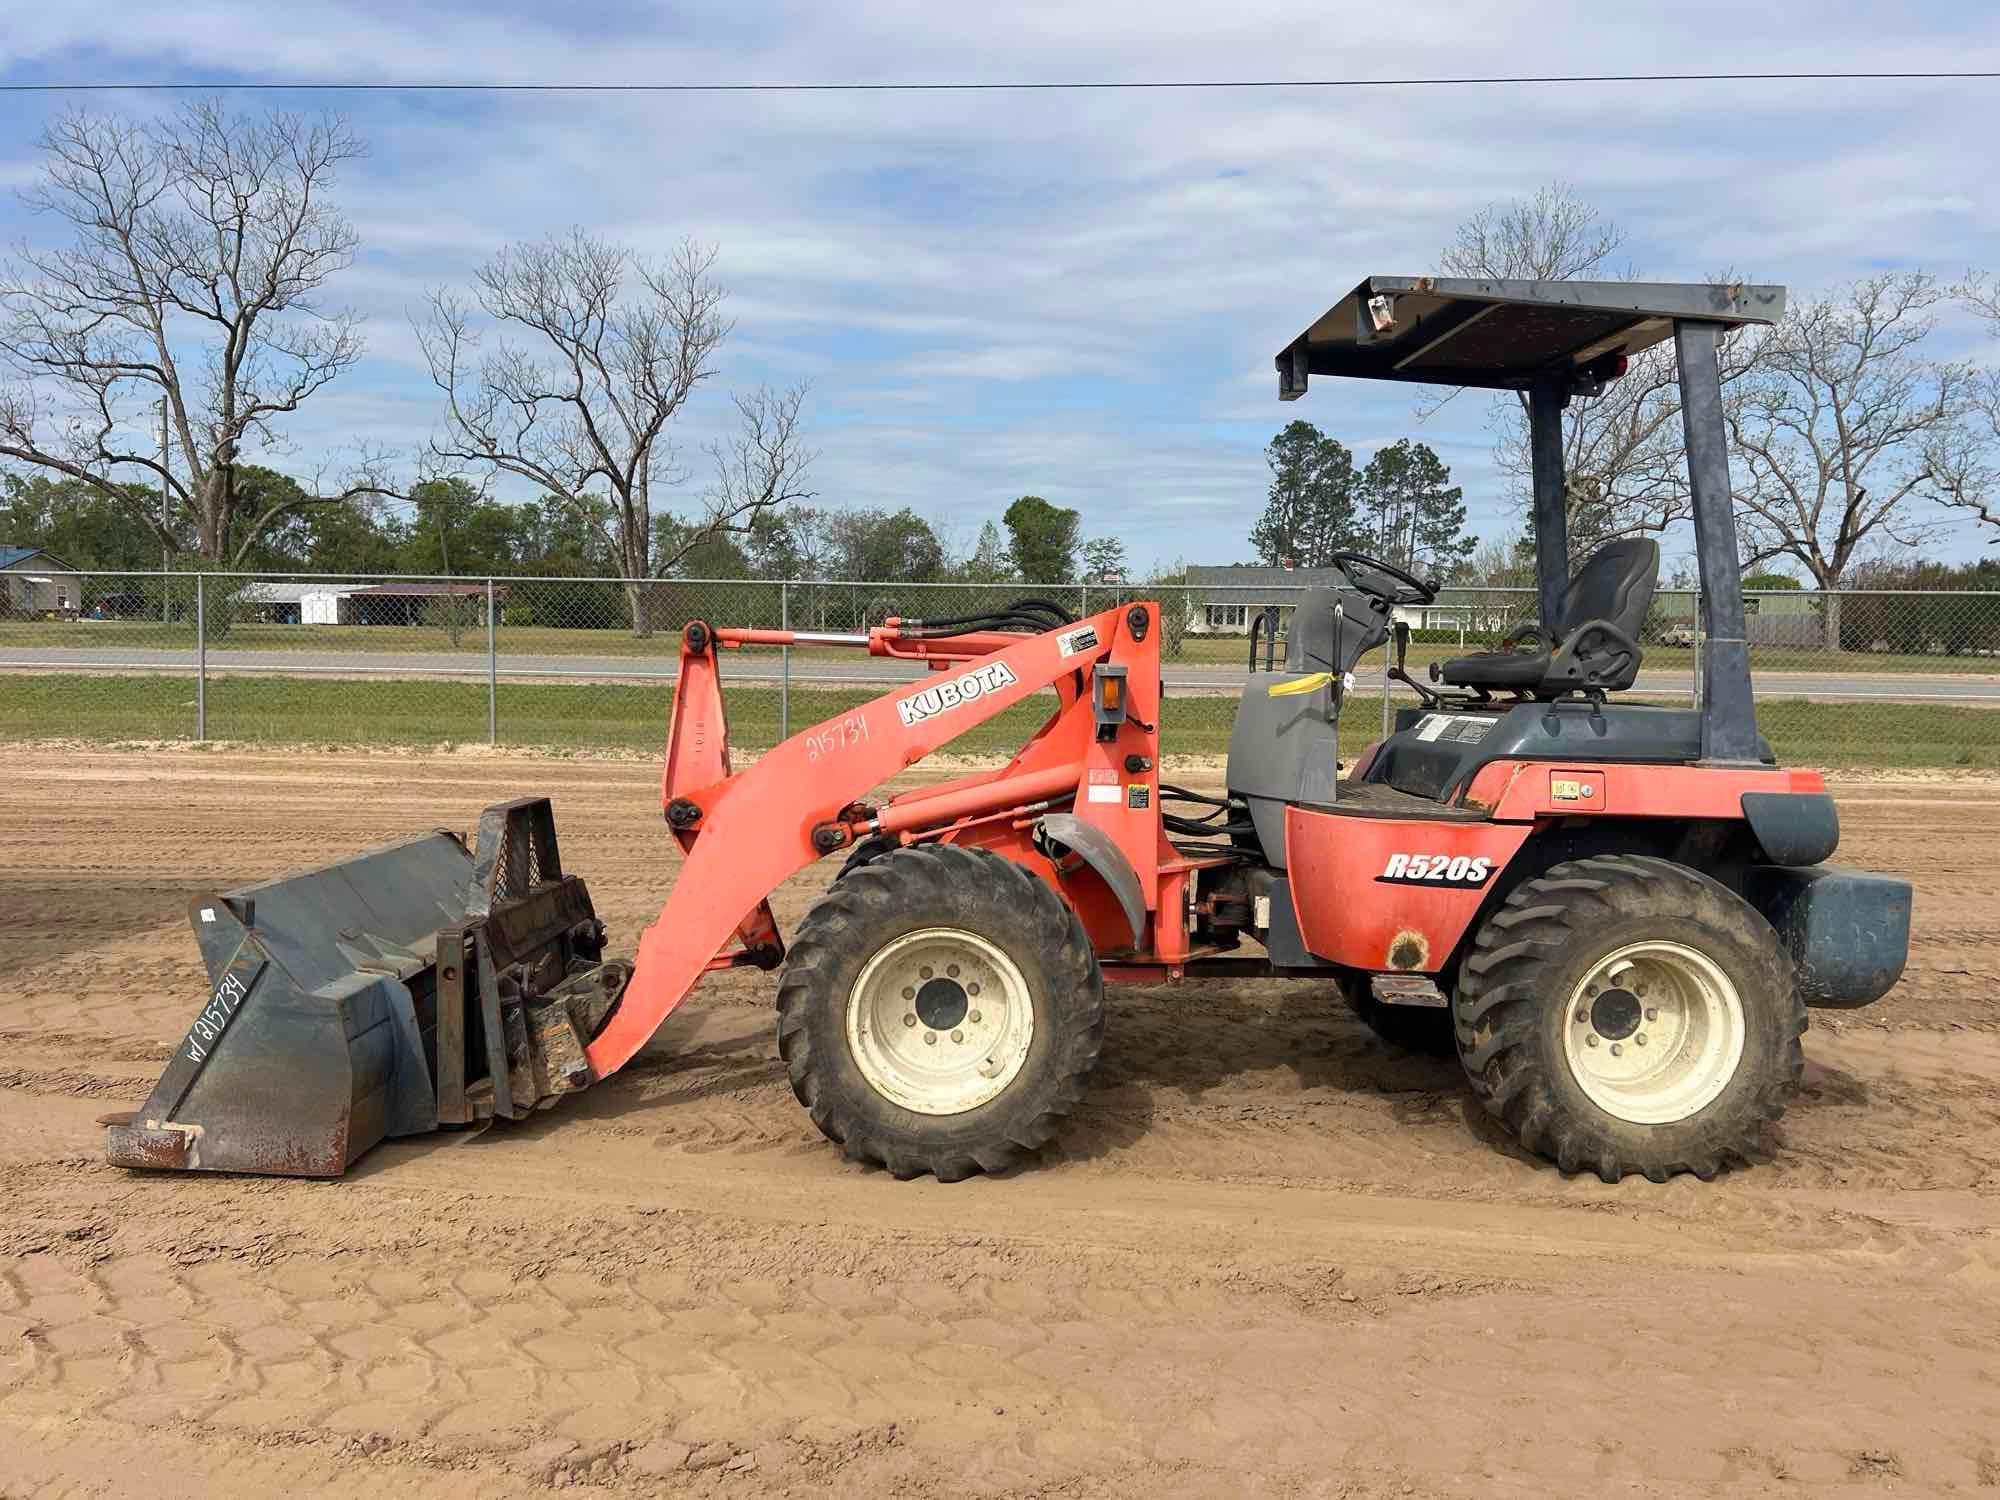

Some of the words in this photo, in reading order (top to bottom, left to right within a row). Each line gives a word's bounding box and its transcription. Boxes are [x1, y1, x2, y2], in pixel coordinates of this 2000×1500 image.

[898, 662, 1016, 725] KUBOTA
[806, 714, 870, 761] 215734
[1383, 853, 1491, 882] R520S
[194, 973, 248, 1041] 215734
